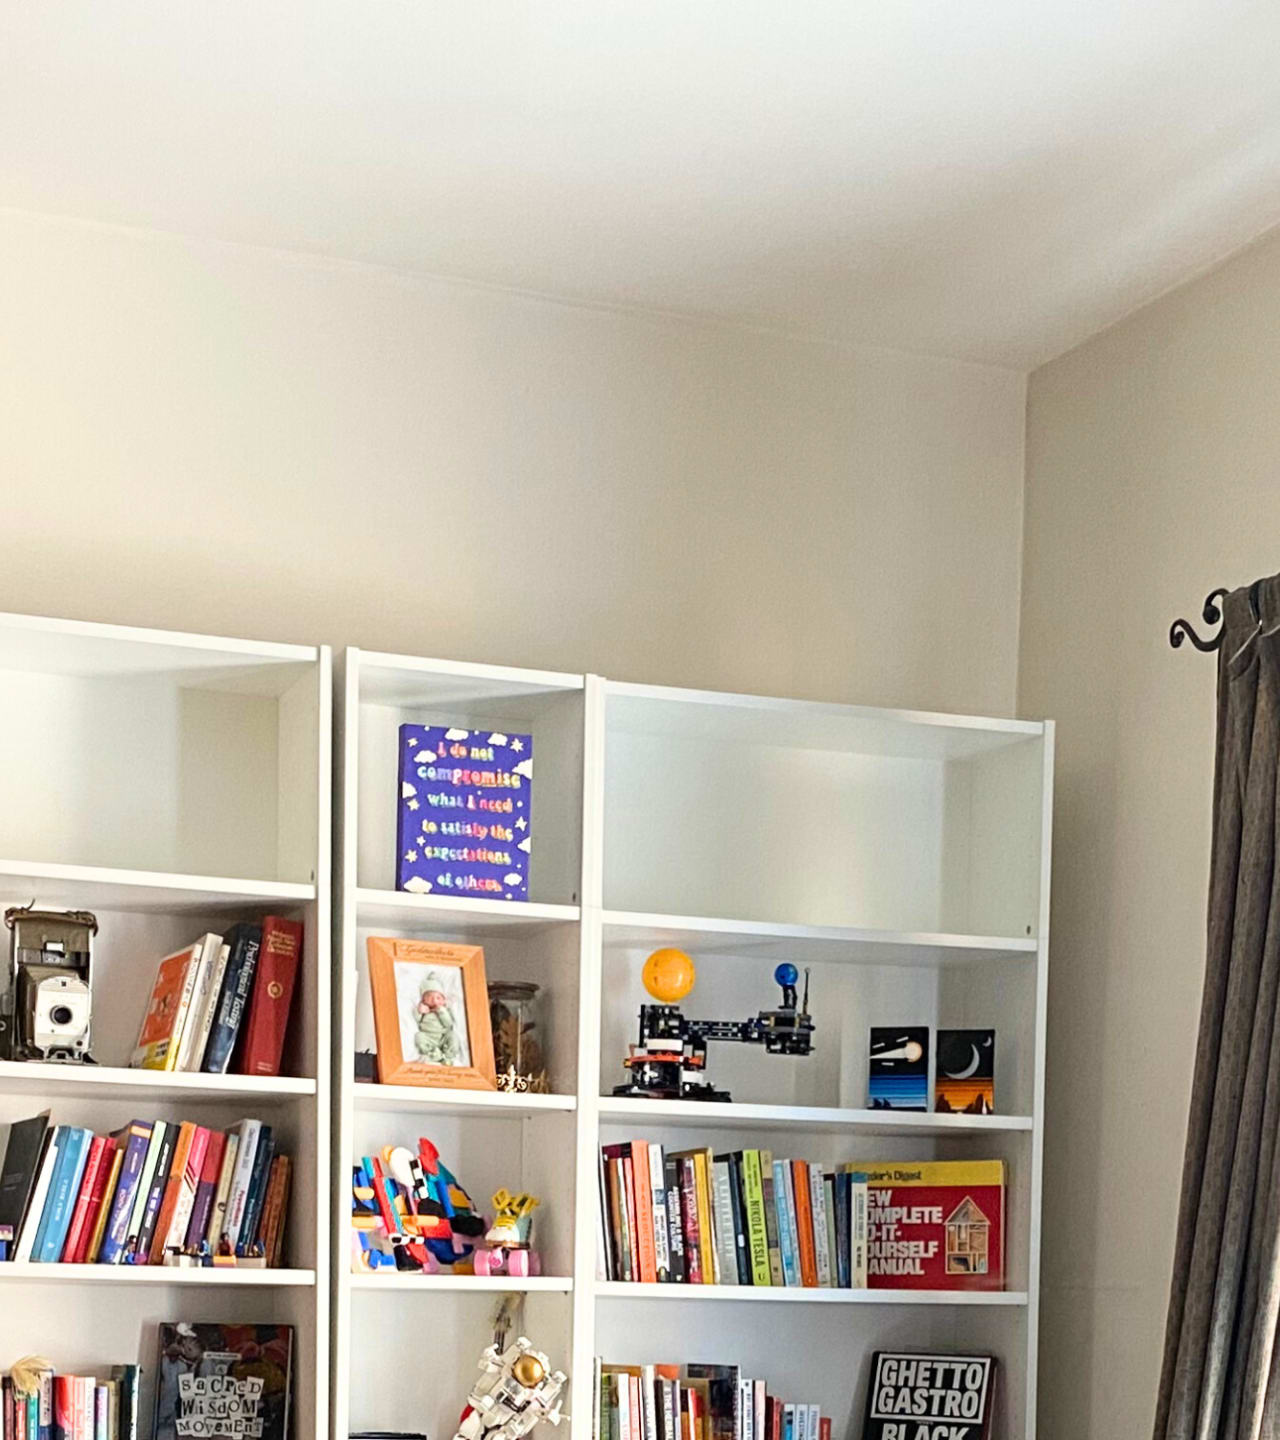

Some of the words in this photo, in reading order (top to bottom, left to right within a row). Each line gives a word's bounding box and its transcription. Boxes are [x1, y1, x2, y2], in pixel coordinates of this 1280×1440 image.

[450, 743, 467, 758] do
[470, 747, 494, 761] not
[417, 766, 521, 788] compromise
[427, 792, 463, 808] what
[479, 798, 513, 813] need
[422, 819, 437, 833] to
[441, 821, 488, 839] satisfy
[490, 824, 513, 842] the
[424, 846, 512, 864] expectations
[225, 996, 246, 1029] Testing
[894, 1171, 922, 1181] Digest
[868, 1190, 892, 1207] EW
[750, 1200, 762, 1235] NIKOLA
[868, 1207, 943, 1224] OMPLETE
[753, 1236, 766, 1267] TESLA
[868, 1241, 939, 1258] OURSELF
[869, 1259, 925, 1276] ANUAL
[881, 1360, 983, 1390] GHETTO
[664, 1395, 672, 1409] THE
[878, 1386, 979, 1417] GASTRO
